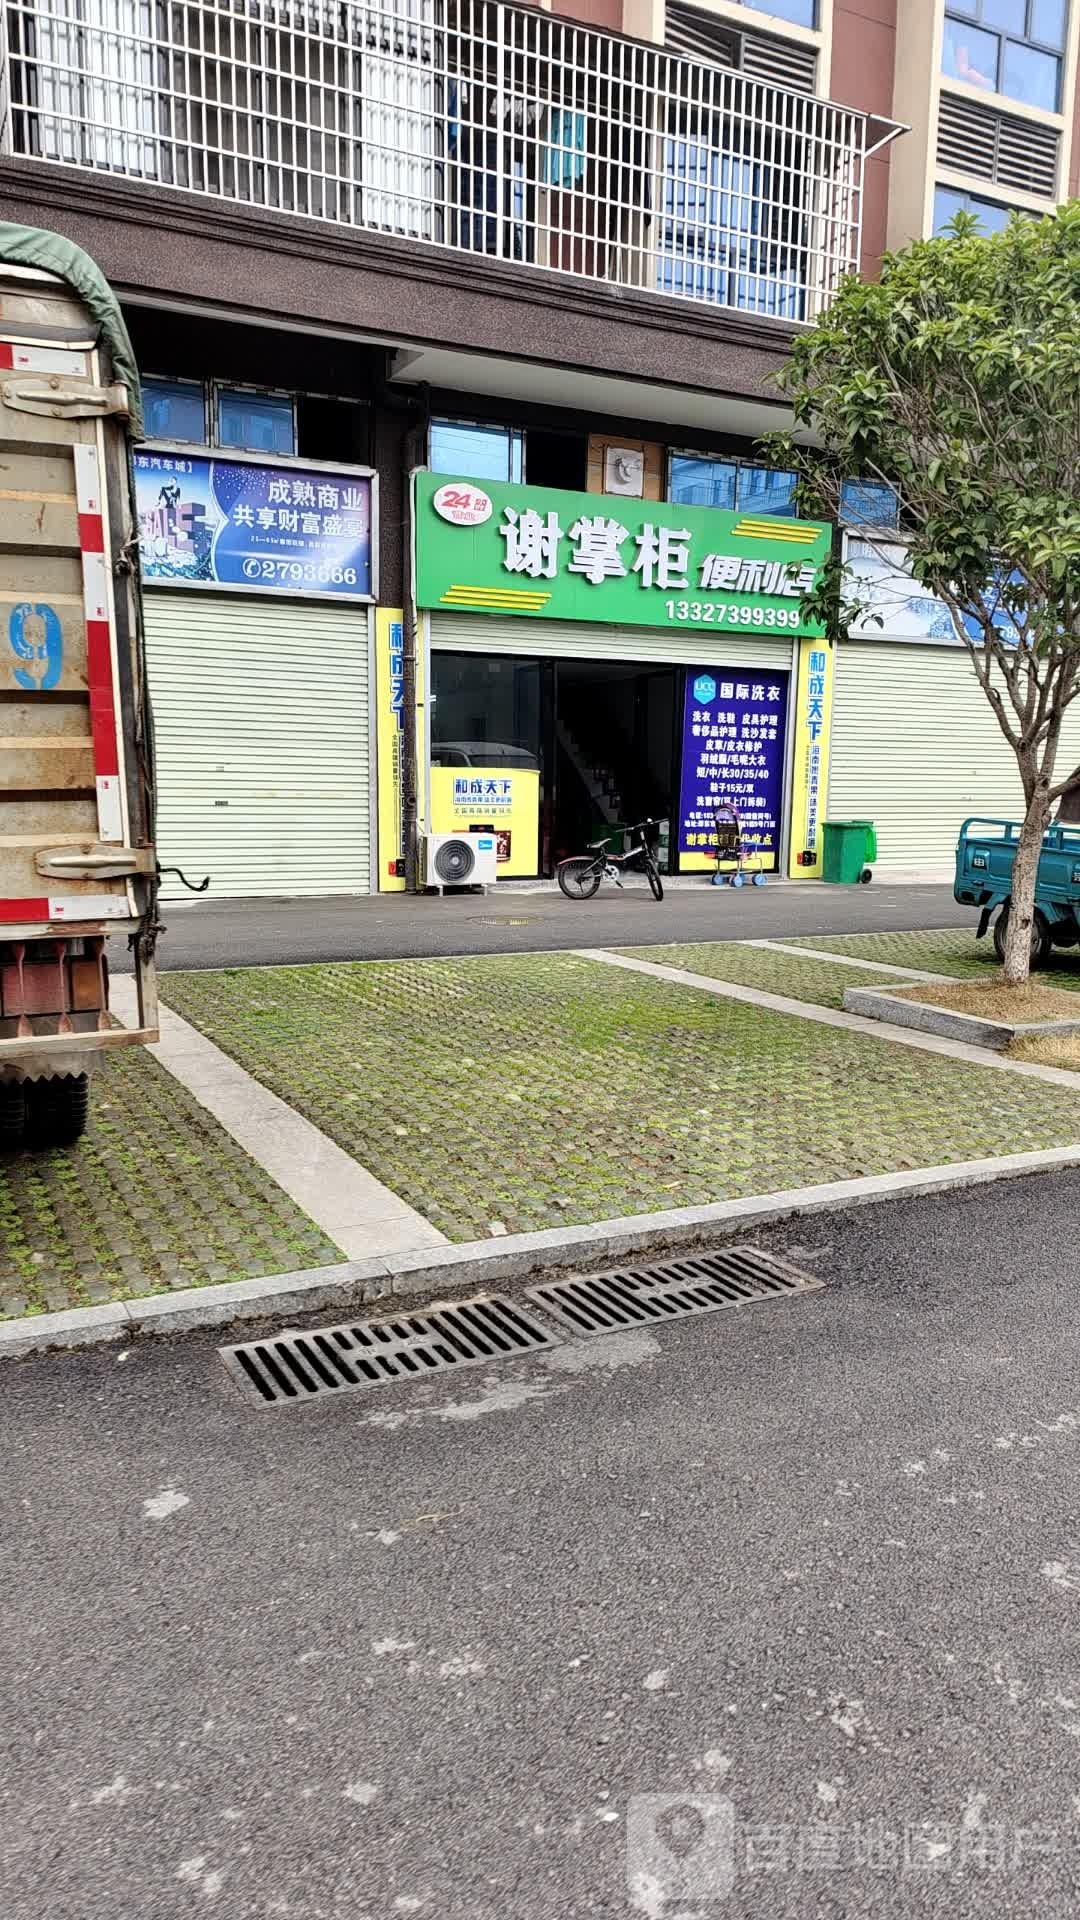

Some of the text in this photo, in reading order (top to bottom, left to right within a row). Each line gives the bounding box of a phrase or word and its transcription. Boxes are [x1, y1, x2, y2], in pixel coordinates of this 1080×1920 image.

[267, 478, 364, 512] 成熟商业
[441, 490, 471, 509] 24
[499, 506, 693, 592] 谢掌柜
[700, 553, 818, 598] 便利店
[665, 599, 800, 629] 13327399399
[9, 602, 62, 689] 9
[720, 682, 781, 701] 国际洗衣
[807, 650, 826, 741] 和成天下
[692, 710, 711, 723] 洗衣
[741, 713, 778, 726] 皮具护理
[455, 778, 513, 794] 和成天下
